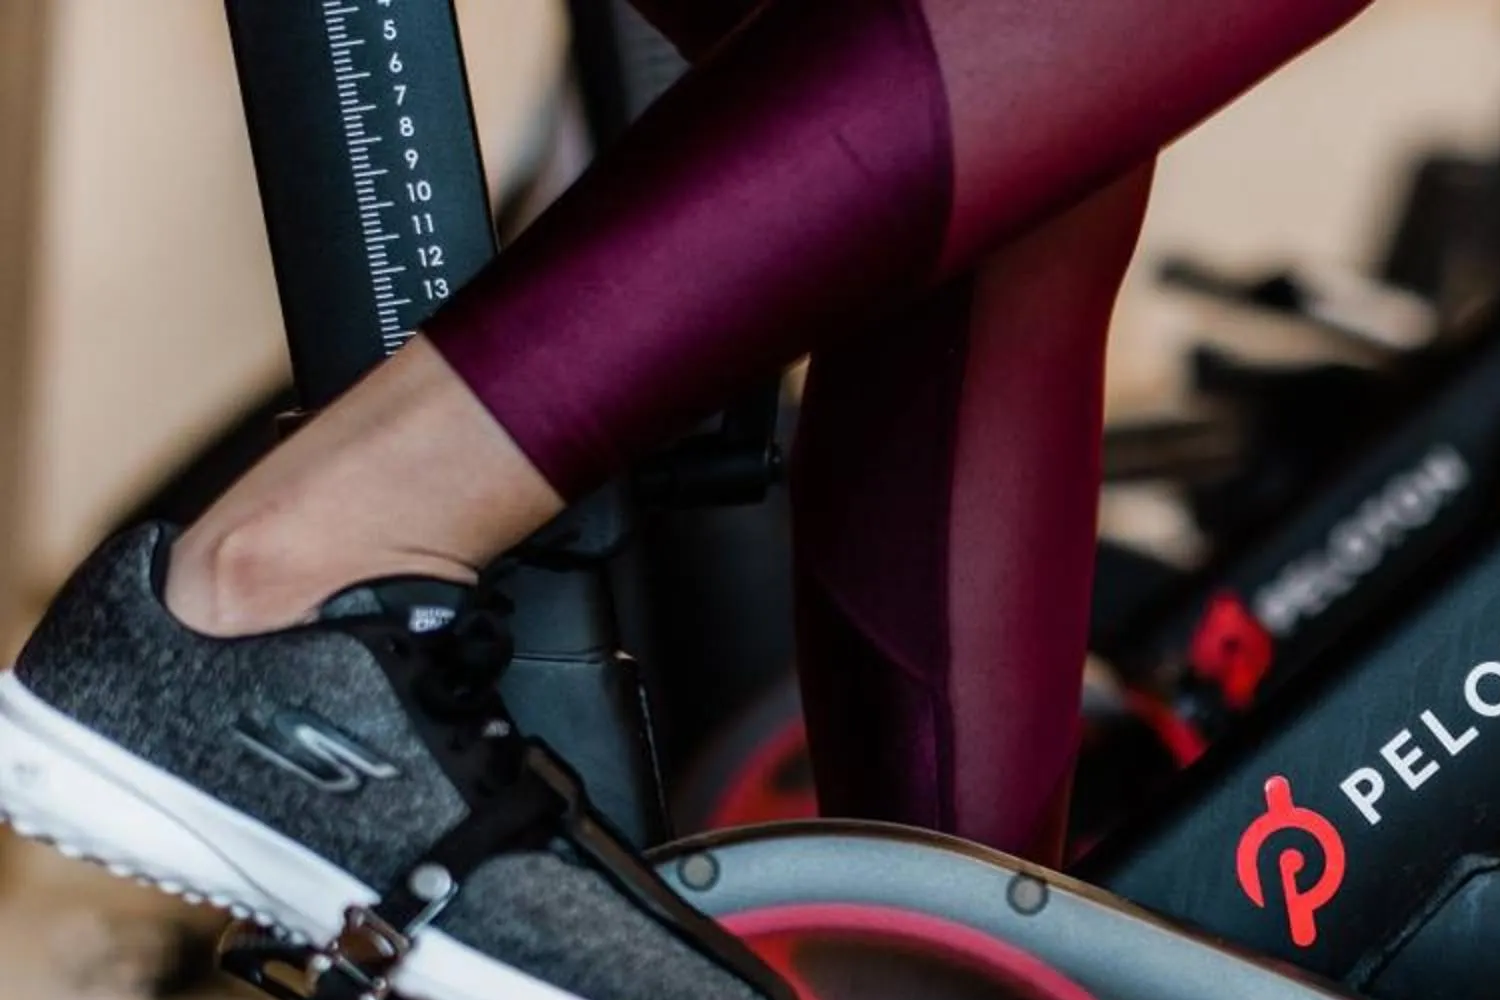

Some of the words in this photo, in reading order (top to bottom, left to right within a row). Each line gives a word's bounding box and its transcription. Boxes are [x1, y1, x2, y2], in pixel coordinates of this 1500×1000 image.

[383, 18, 398, 41] 5
[388, 52, 403, 74] 6
[393, 84, 407, 106] 7
[399, 115, 415, 137] 8
[404, 148, 419, 170] 9
[405, 180, 433, 203] 10
[411, 213, 435, 235] 11
[417, 245, 445, 268] 12
[423, 277, 449, 300] 13
